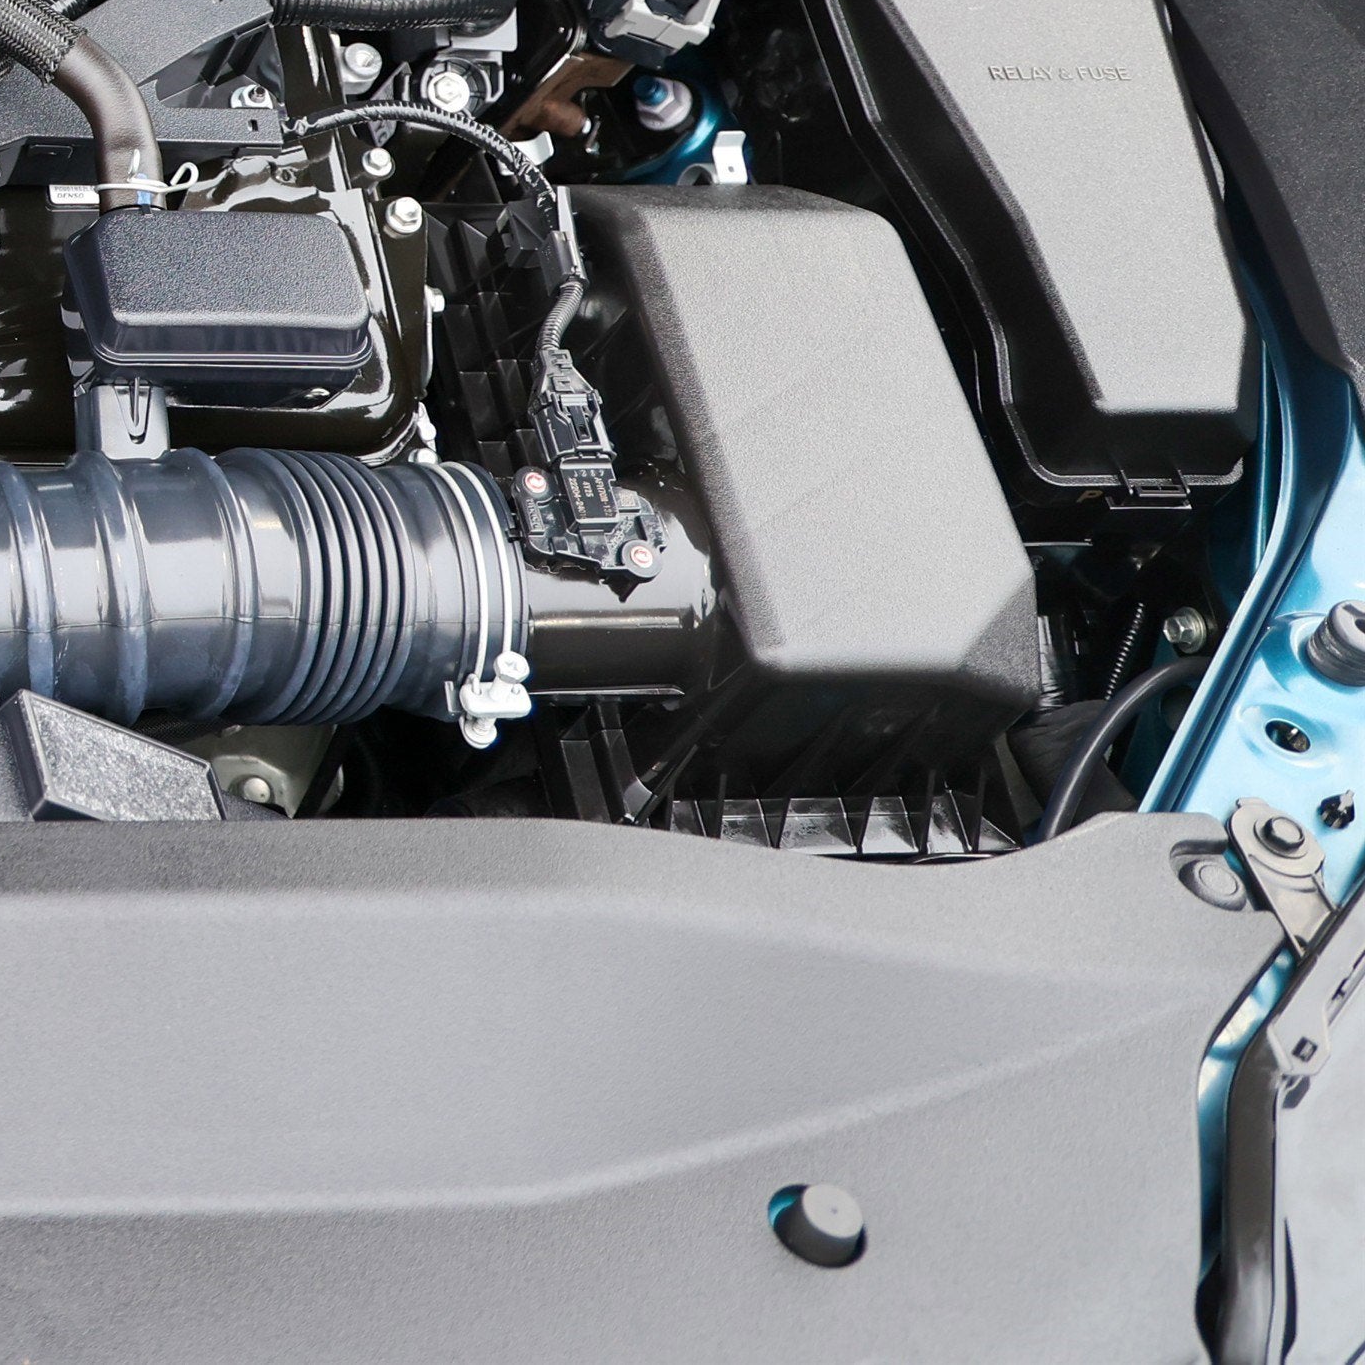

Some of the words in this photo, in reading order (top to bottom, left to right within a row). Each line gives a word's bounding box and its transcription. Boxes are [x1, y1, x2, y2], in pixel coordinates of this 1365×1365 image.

[988, 65, 1053, 82] RELAY
[1059, 67, 1074, 81] &
[1077, 65, 1133, 82] FUSE
